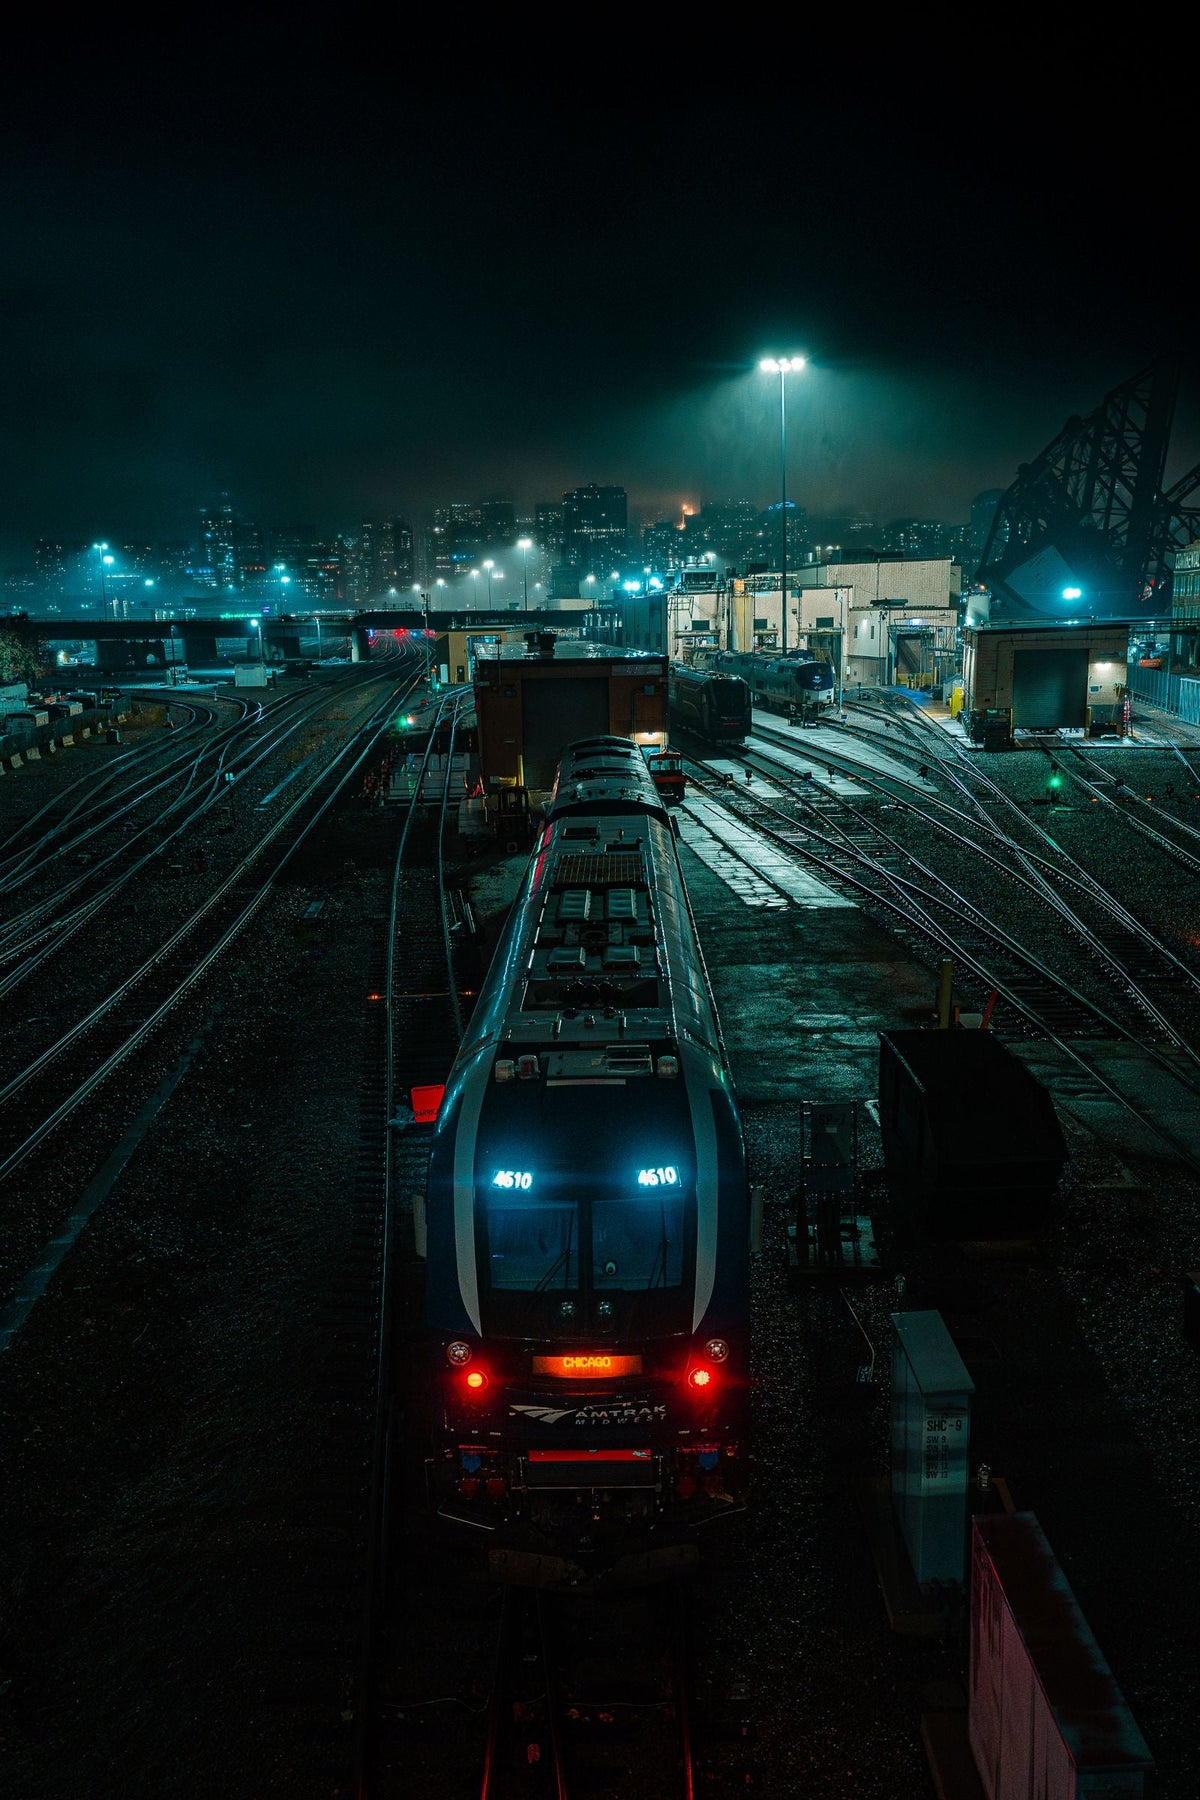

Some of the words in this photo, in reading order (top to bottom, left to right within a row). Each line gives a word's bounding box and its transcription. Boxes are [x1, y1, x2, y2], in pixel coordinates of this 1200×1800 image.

[494, 1170, 532, 1190] 4610
[638, 1166, 676, 1186] 4610
[563, 1356, 612, 1368] CHICAGO
[576, 1405, 667, 1418] AMTRAK
[576, 1413, 667, 1425] MIDWEST
[927, 1435, 939, 1444] SW
[941, 1435, 947, 1444] 9
[925, 1471, 939, 1479] SW
